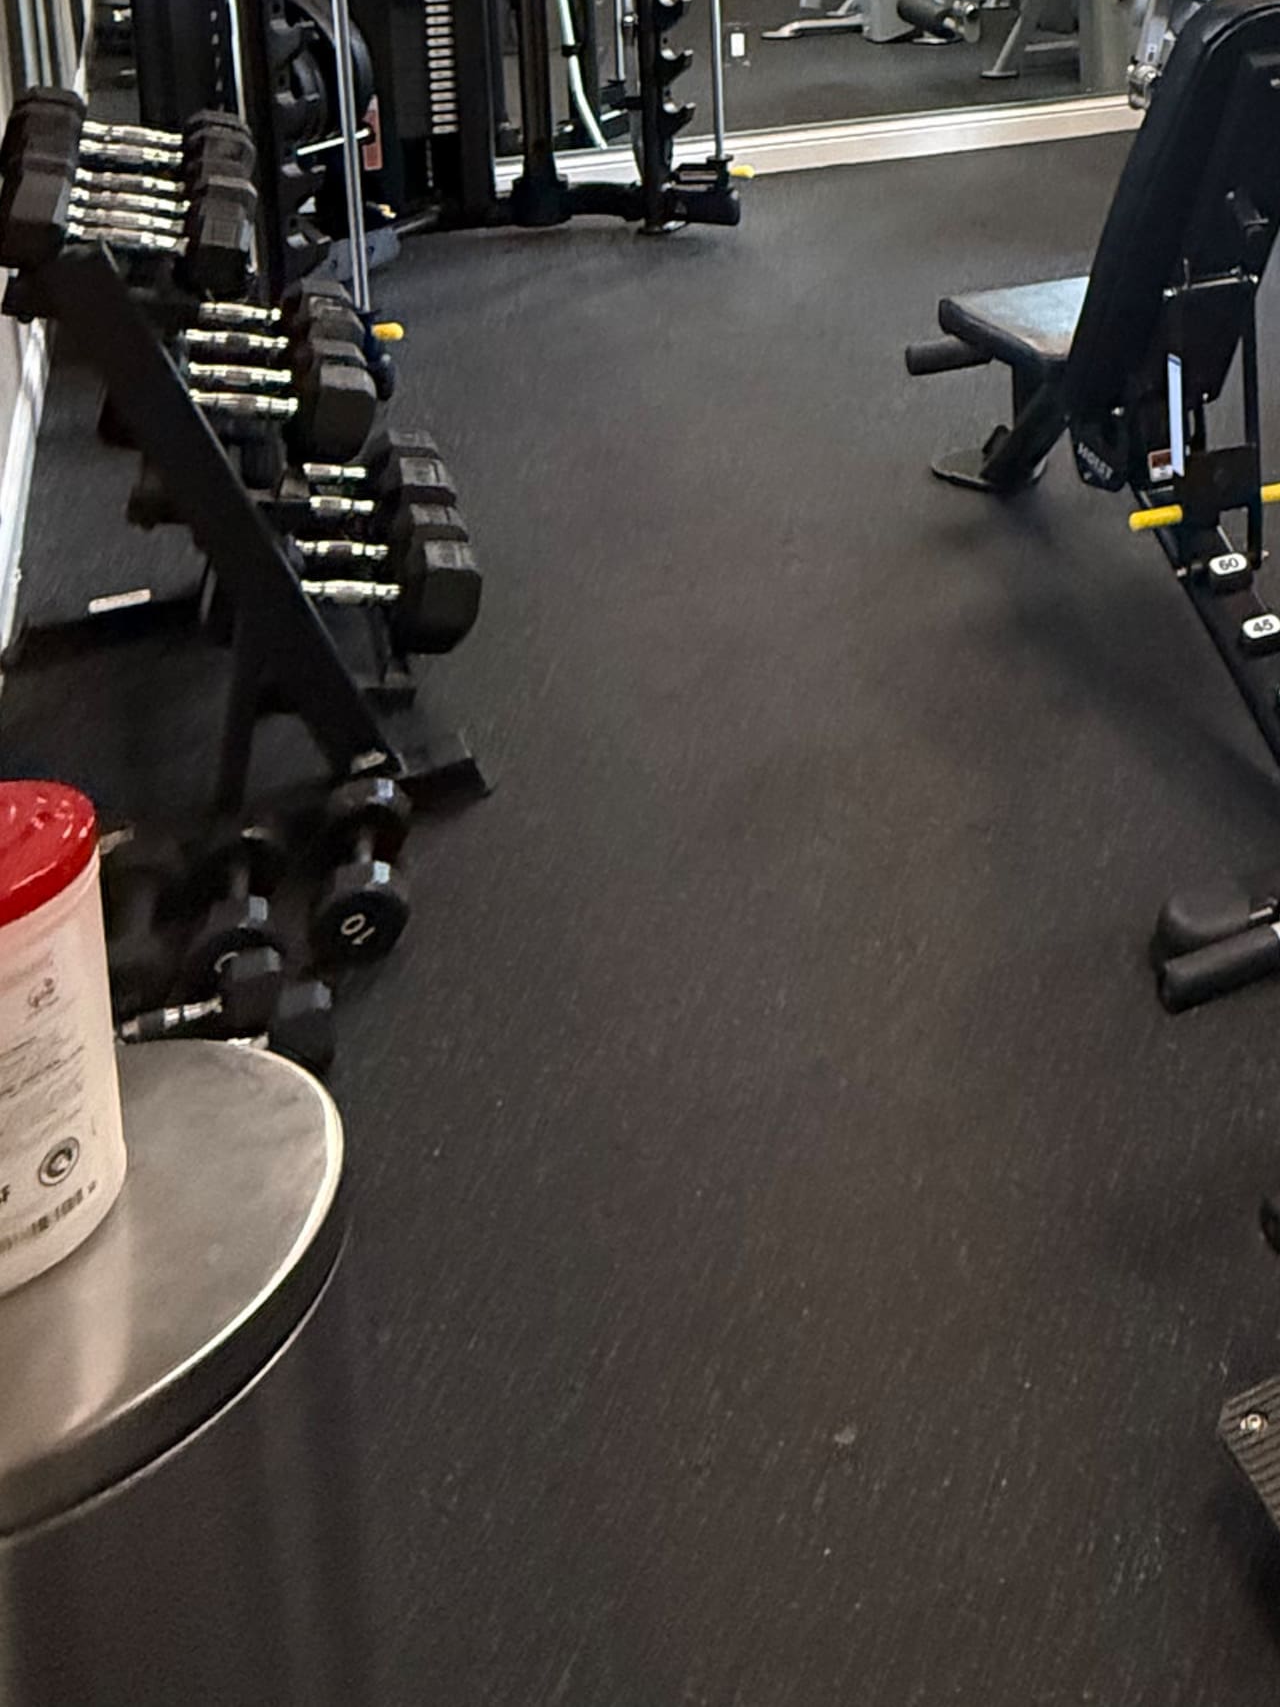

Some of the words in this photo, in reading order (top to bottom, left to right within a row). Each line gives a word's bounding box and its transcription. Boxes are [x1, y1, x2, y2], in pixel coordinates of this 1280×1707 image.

[1218, 557, 1239, 571] 60
[1253, 618, 1274, 632] 45
[340, 913, 376, 944] 10
